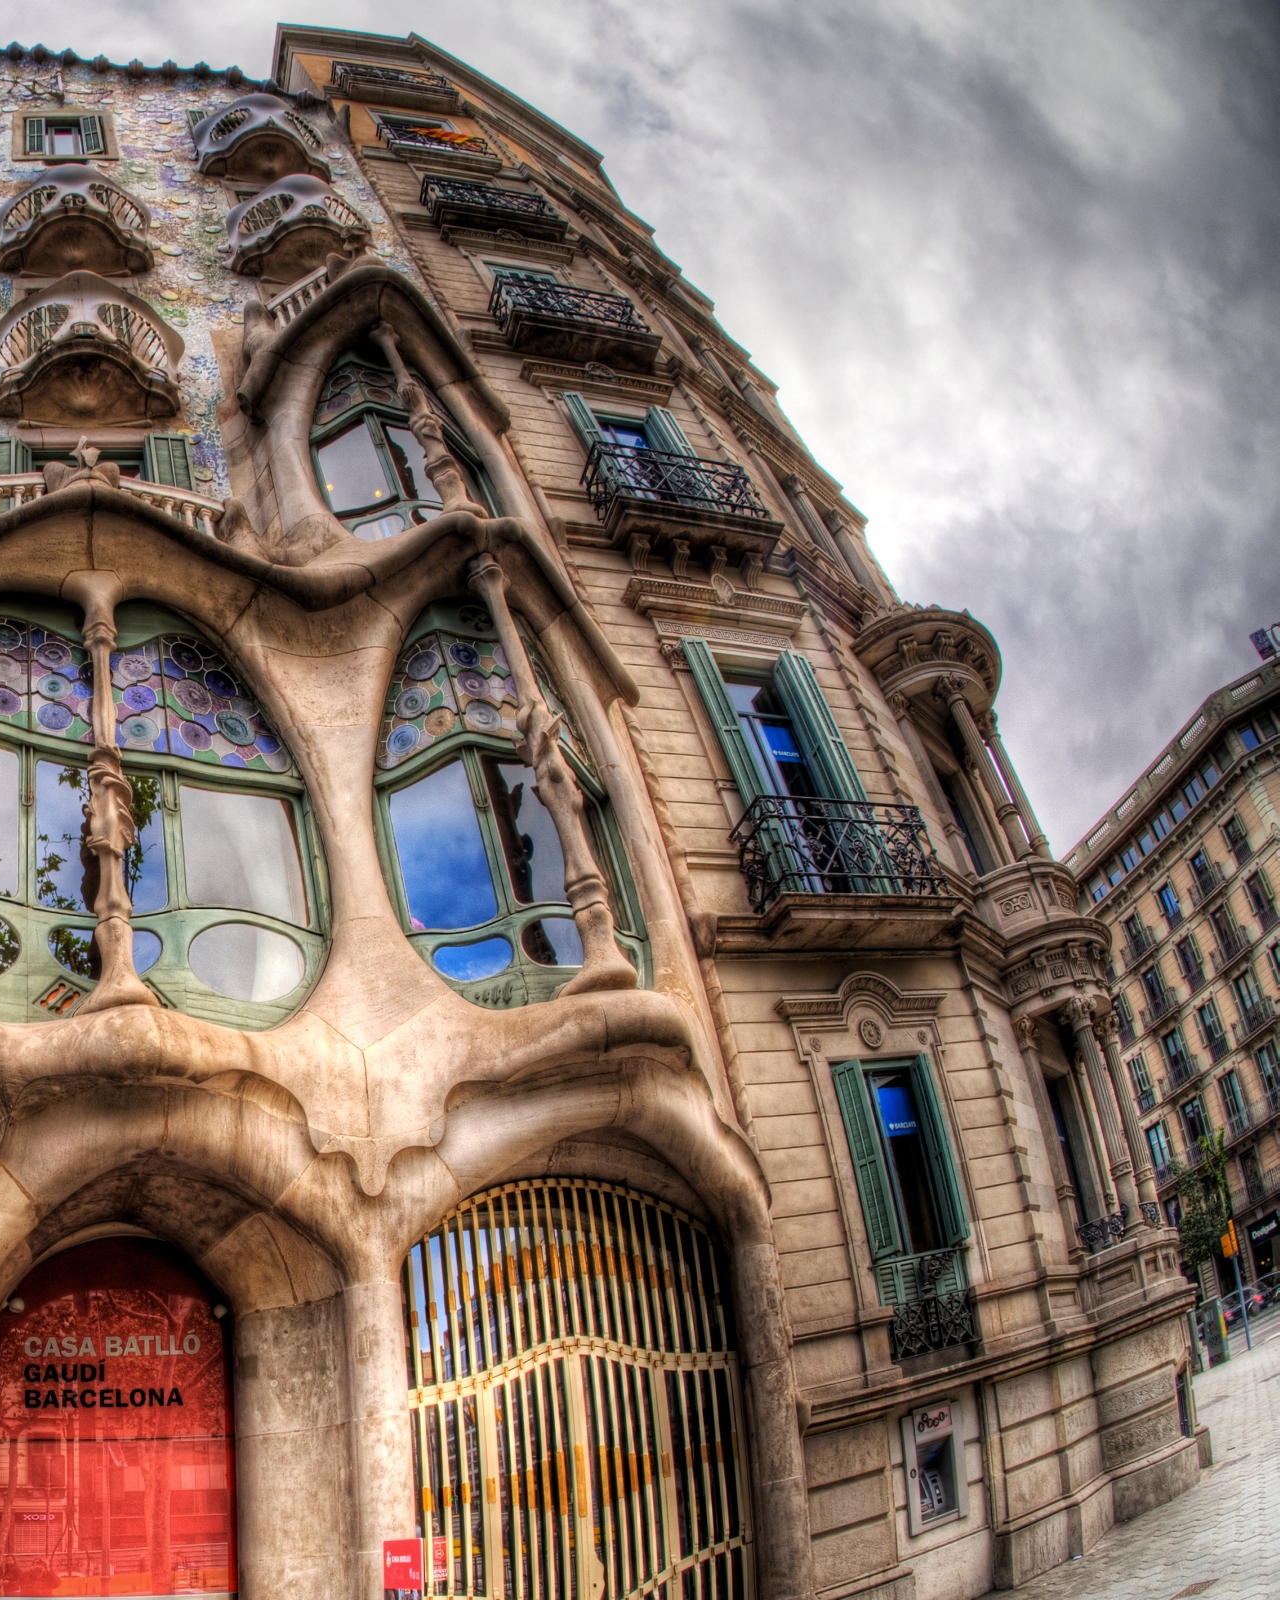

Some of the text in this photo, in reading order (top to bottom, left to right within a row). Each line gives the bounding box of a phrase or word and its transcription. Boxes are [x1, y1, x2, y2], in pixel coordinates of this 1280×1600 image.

[894, 1121, 917, 1129] BARCLAYS
[1251, 1220, 1277, 1240] Desigual
[24, 1329, 201, 1358] CASA BATLLÓ
[24, 1359, 106, 1383] GAUDÍ
[24, 1387, 184, 1409] BARCELONA
